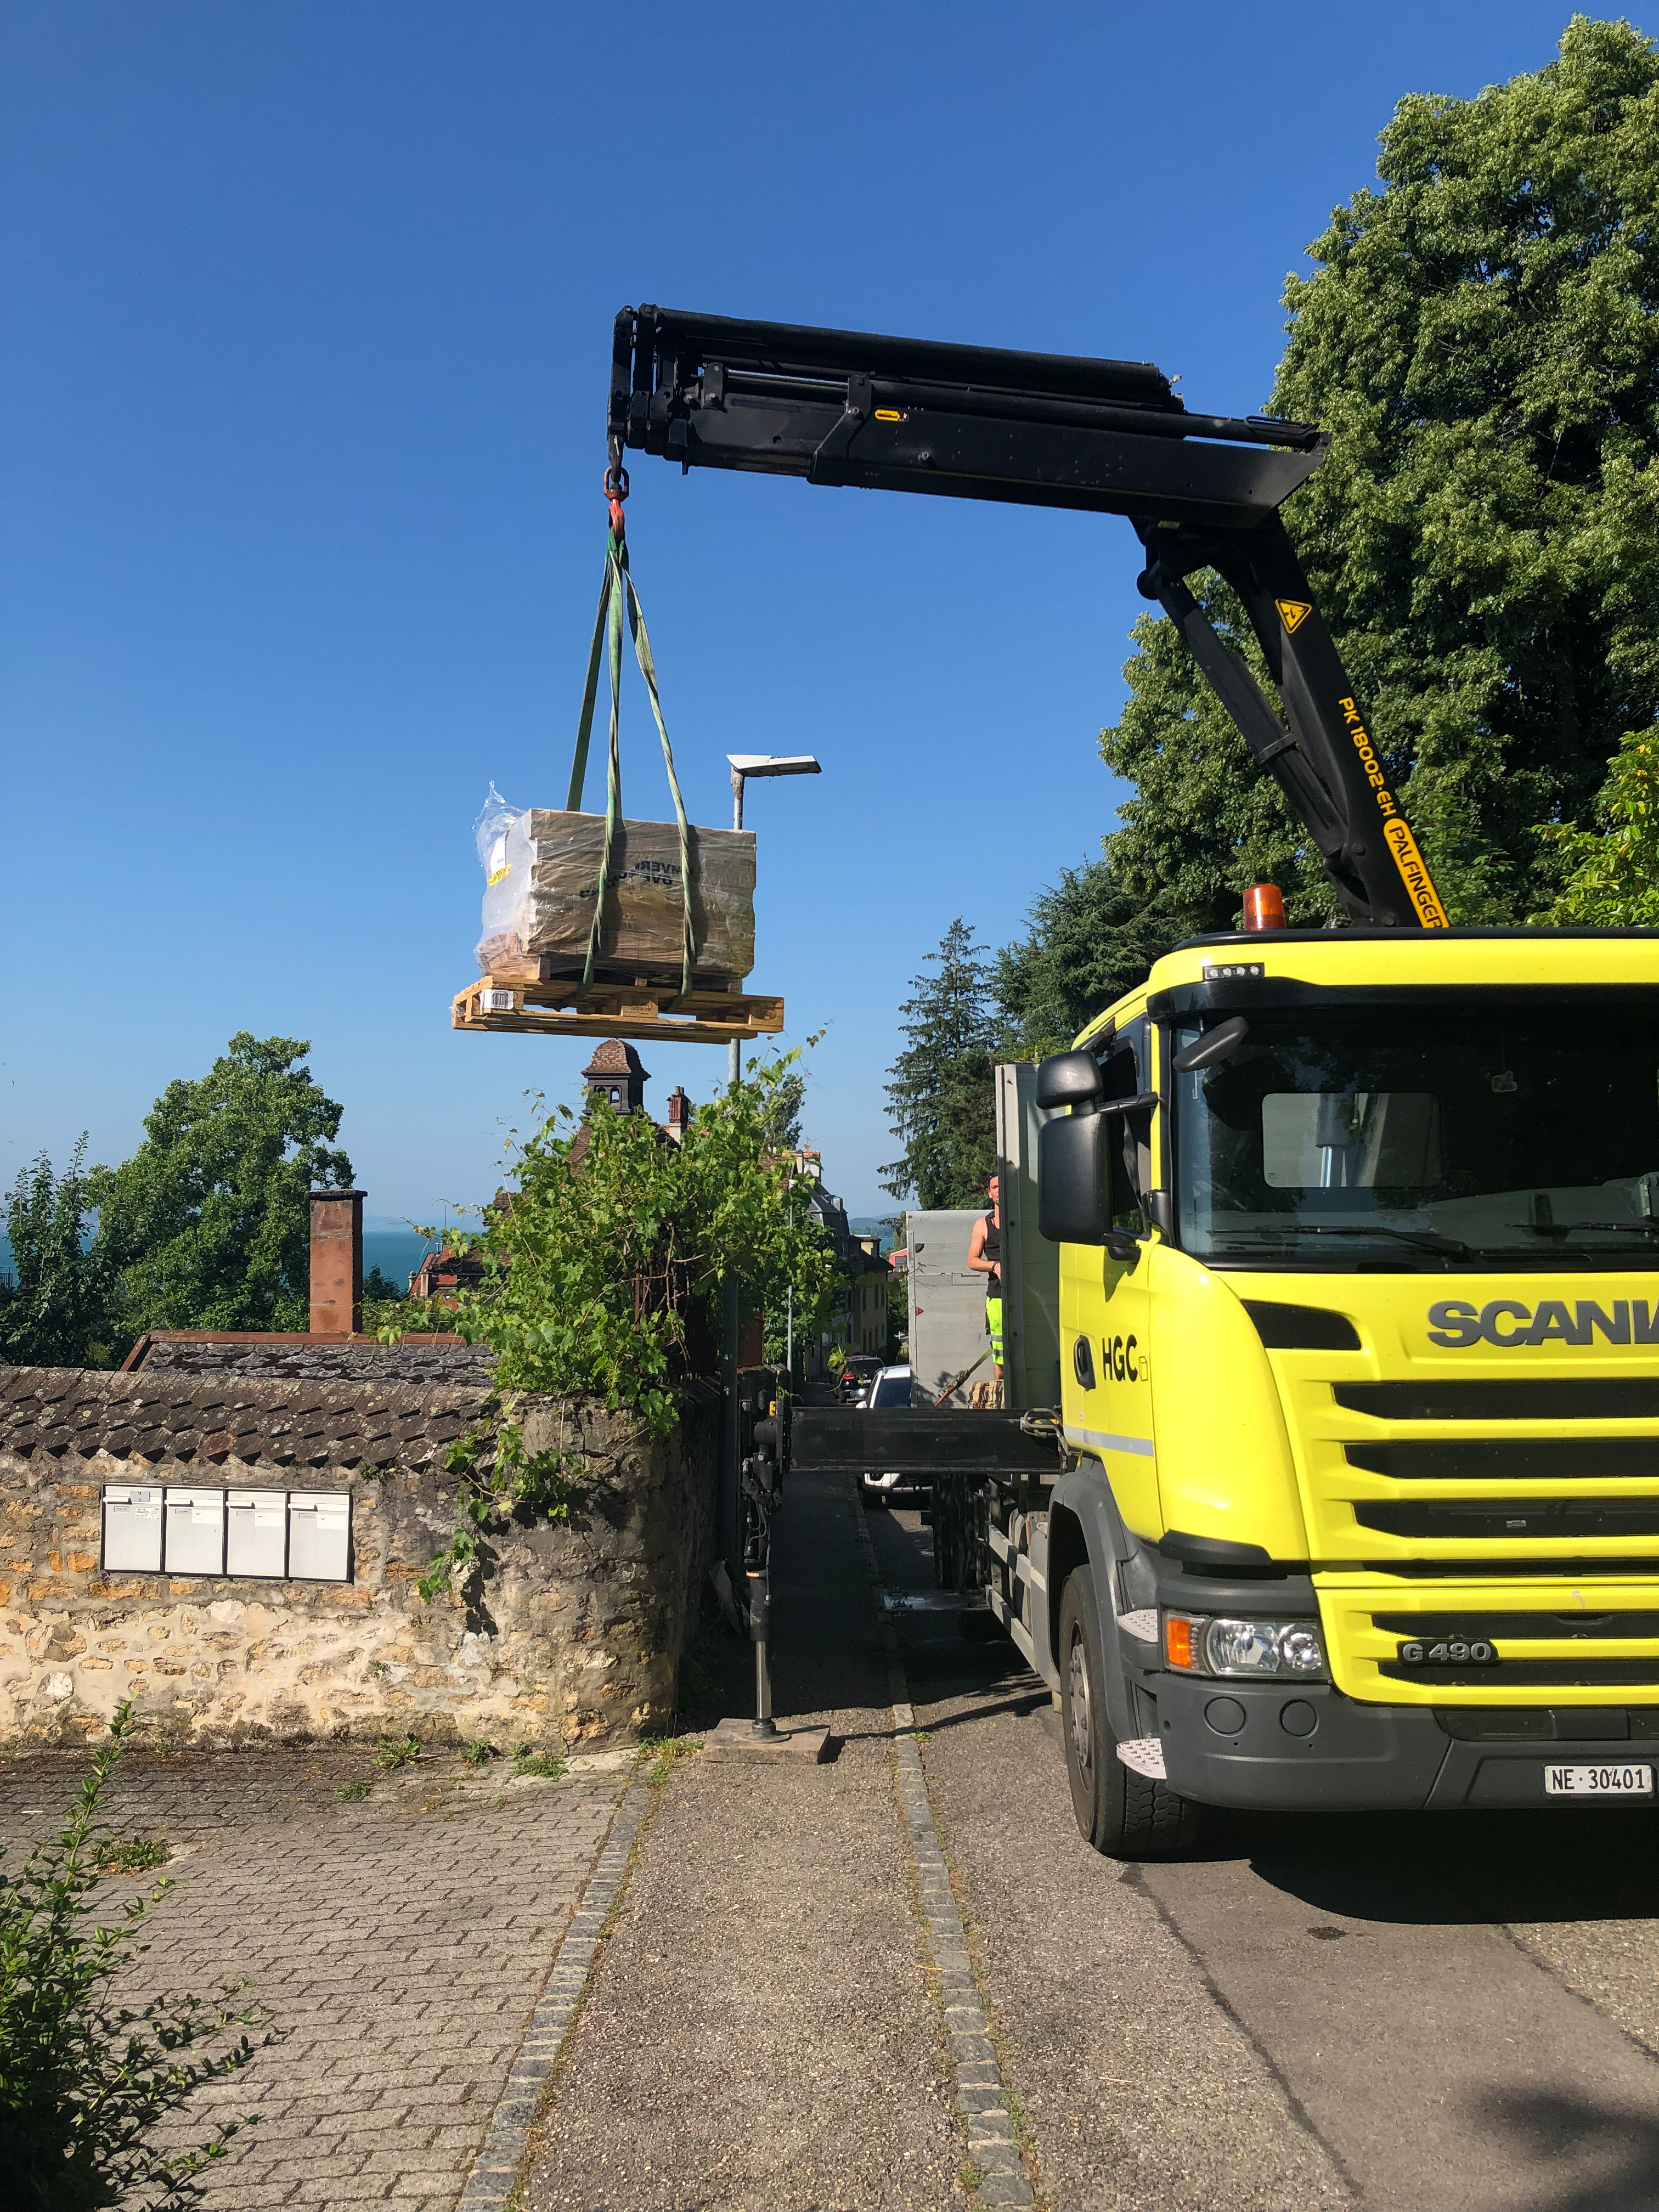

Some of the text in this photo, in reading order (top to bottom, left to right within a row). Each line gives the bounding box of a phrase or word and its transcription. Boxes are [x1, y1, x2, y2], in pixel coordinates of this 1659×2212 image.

[1339, 697, 1360, 725] PK
[1427, 1300, 1659, 1347] SCANI
[1102, 1334, 1138, 1382] HGC
[1403, 1643, 1492, 1662] G 490
